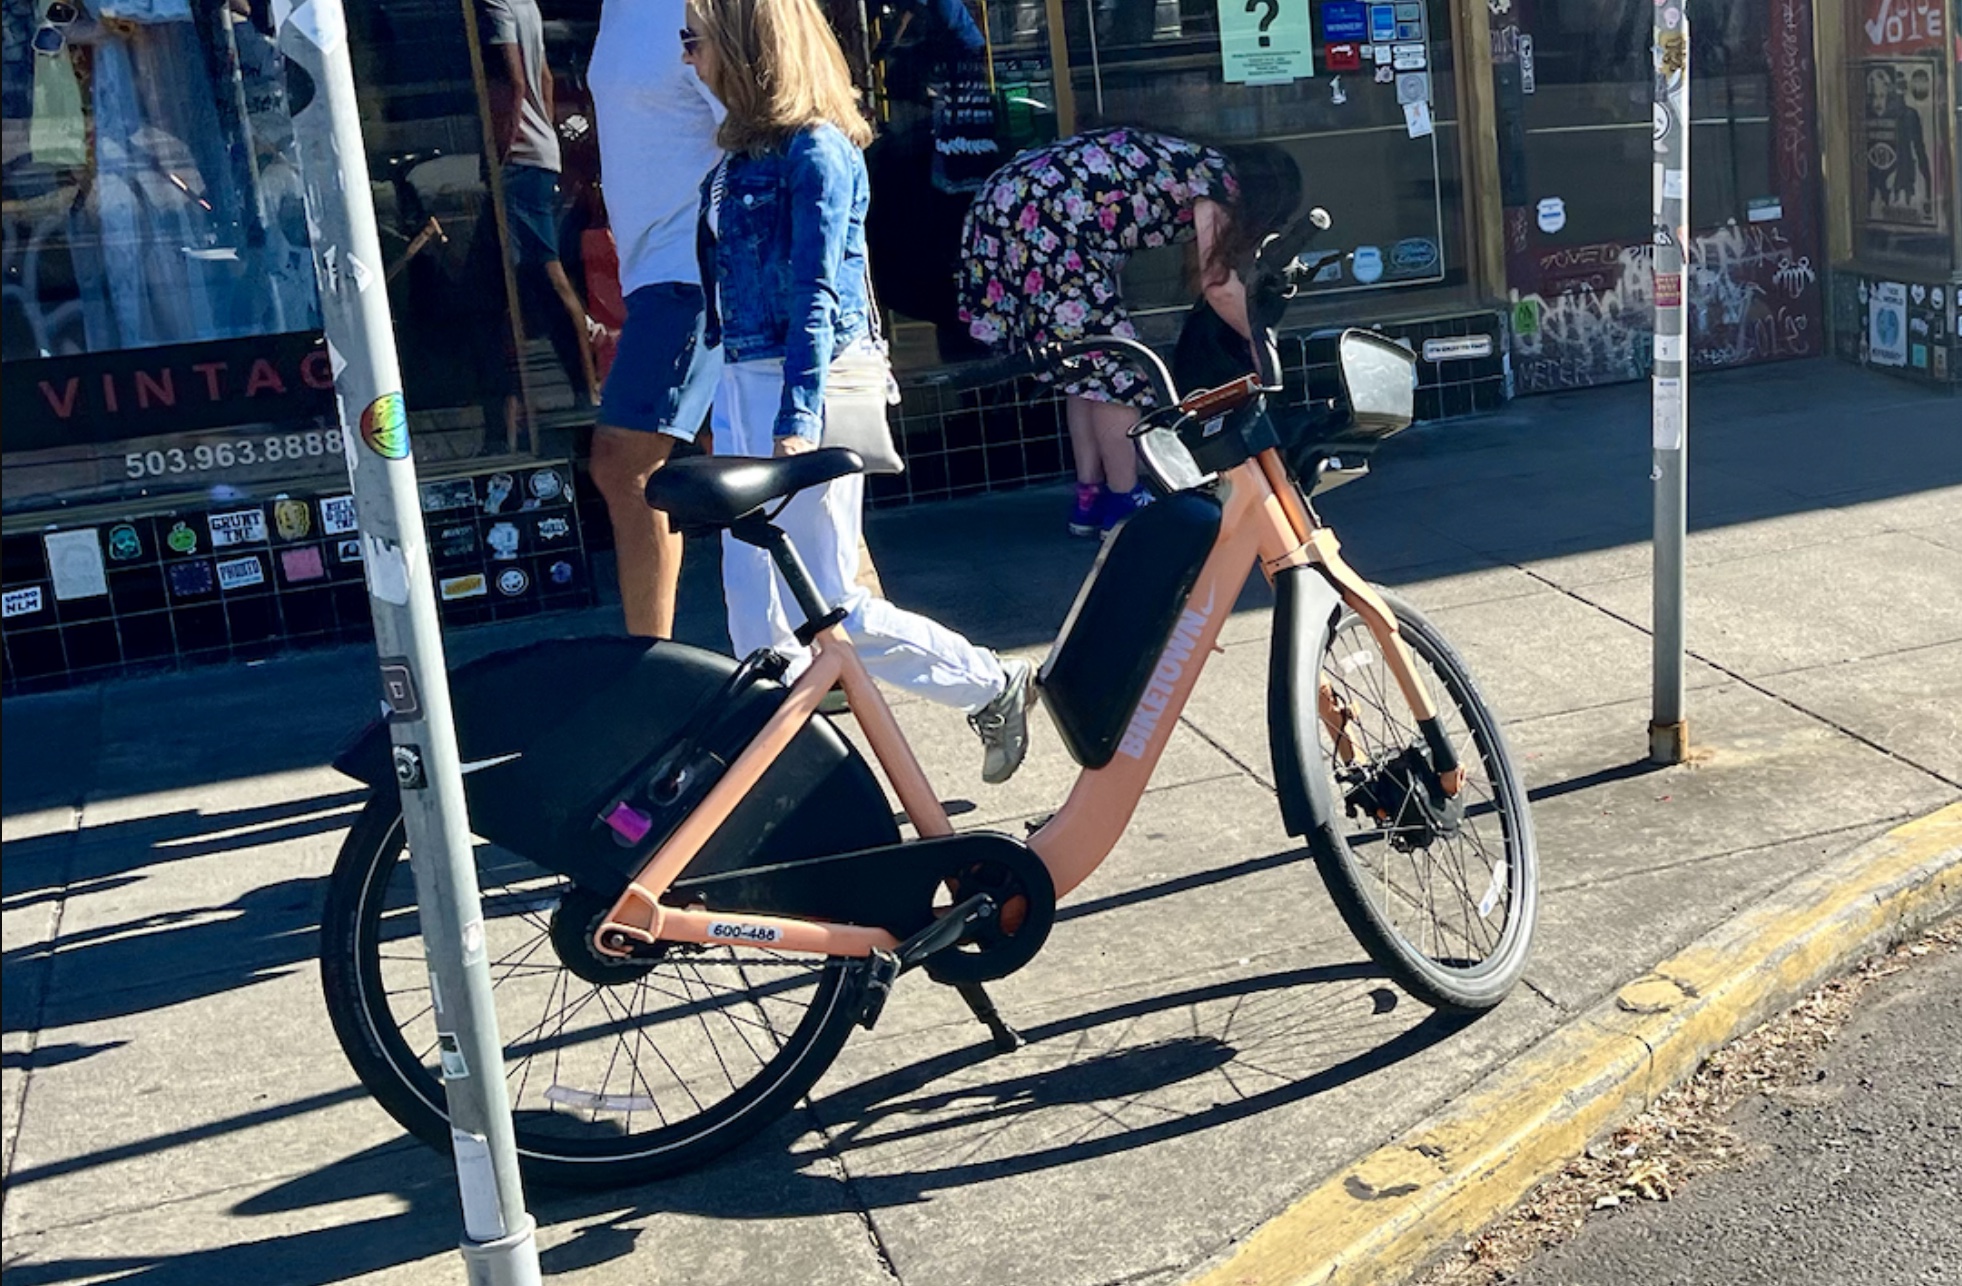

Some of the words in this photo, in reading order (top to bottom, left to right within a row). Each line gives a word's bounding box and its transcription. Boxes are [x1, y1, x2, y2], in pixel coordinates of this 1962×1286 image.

[126, 429, 344, 478] 503.963.8888
[1116, 607, 1209, 760] BIKETOWN
[713, 923, 776, 941] 600-488
